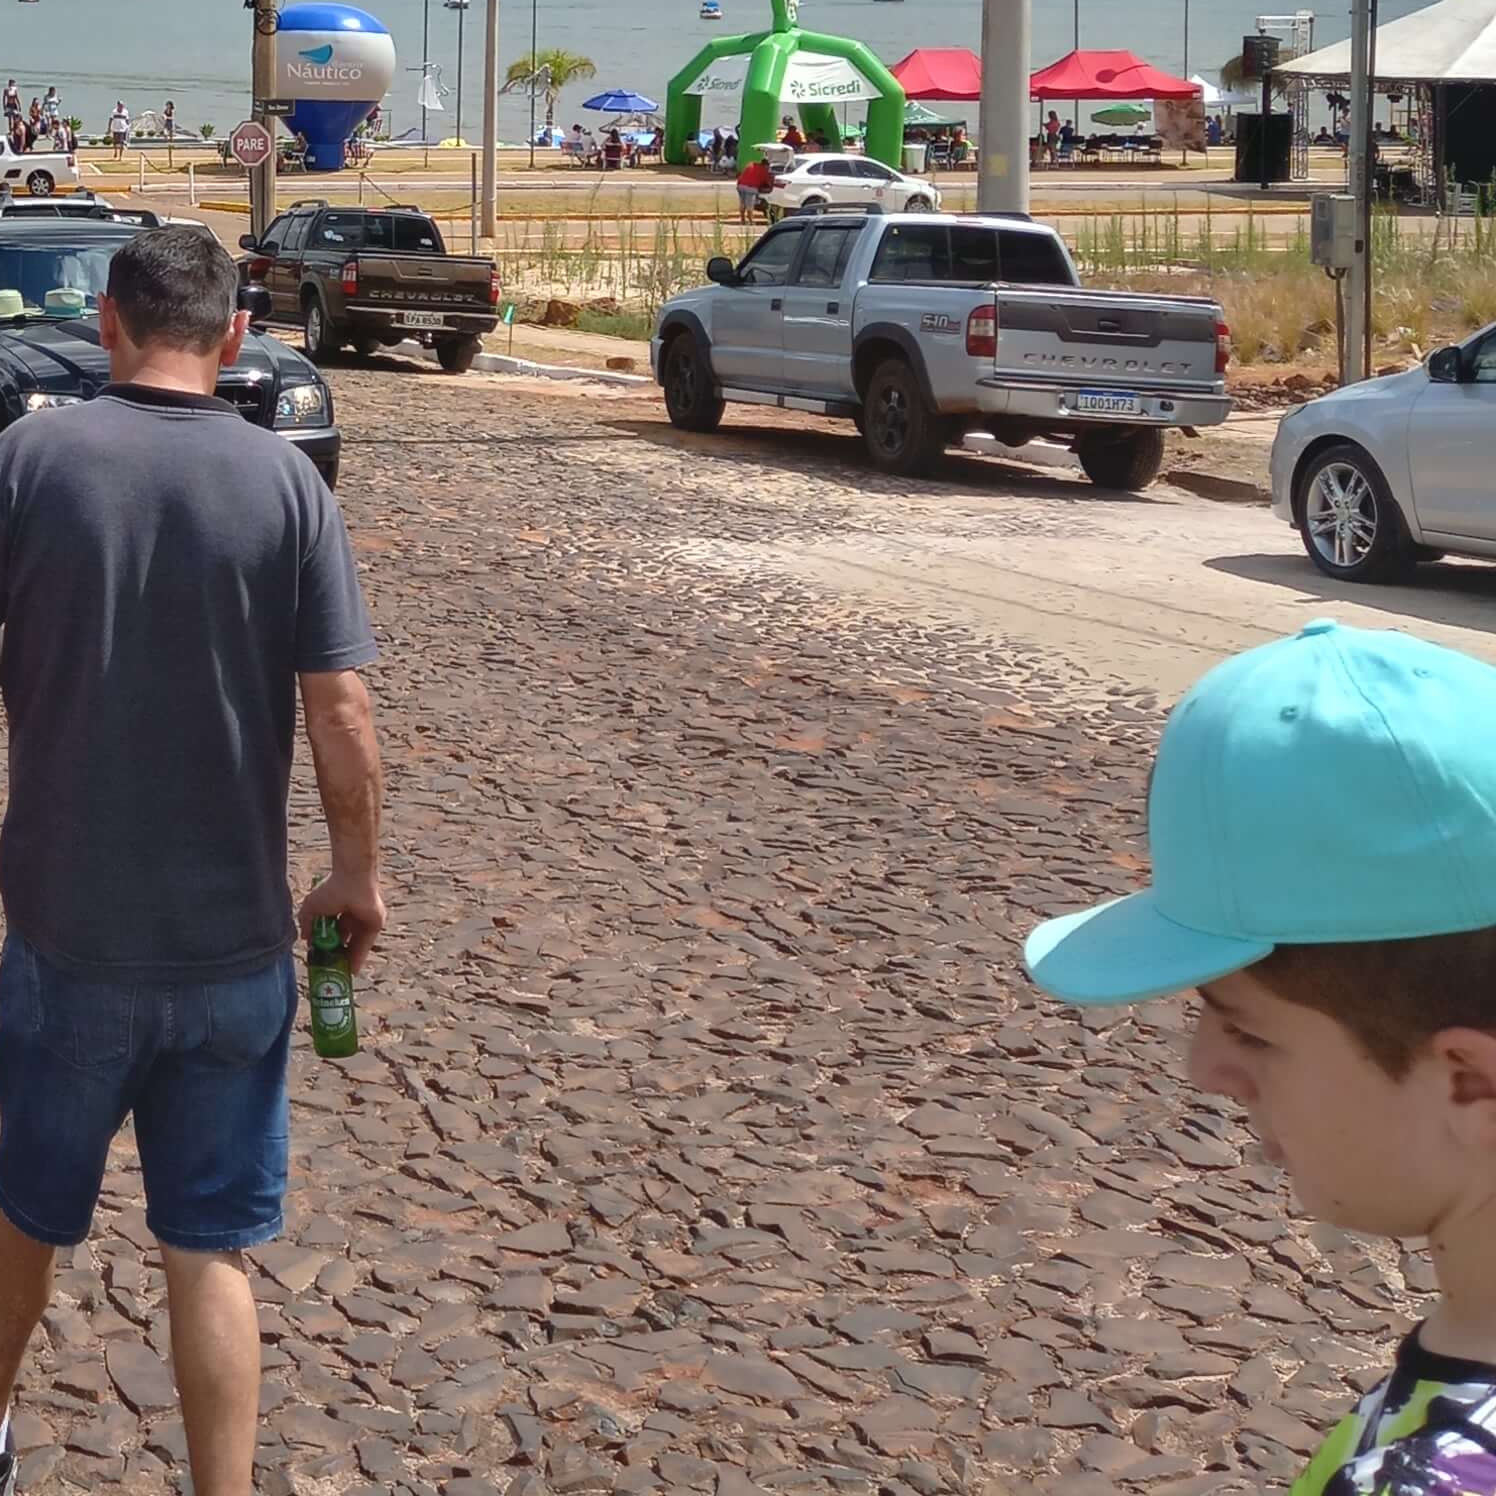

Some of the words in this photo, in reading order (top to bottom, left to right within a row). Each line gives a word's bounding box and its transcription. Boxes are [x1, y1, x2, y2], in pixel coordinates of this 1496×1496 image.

[287, 63, 361, 80] Náutico
[809, 79, 861, 97] Sicredi
[236, 138, 264, 151] PARE
[369, 290, 475, 302] CHEVROLET
[1023, 353, 1192, 375] CHEVROLET
